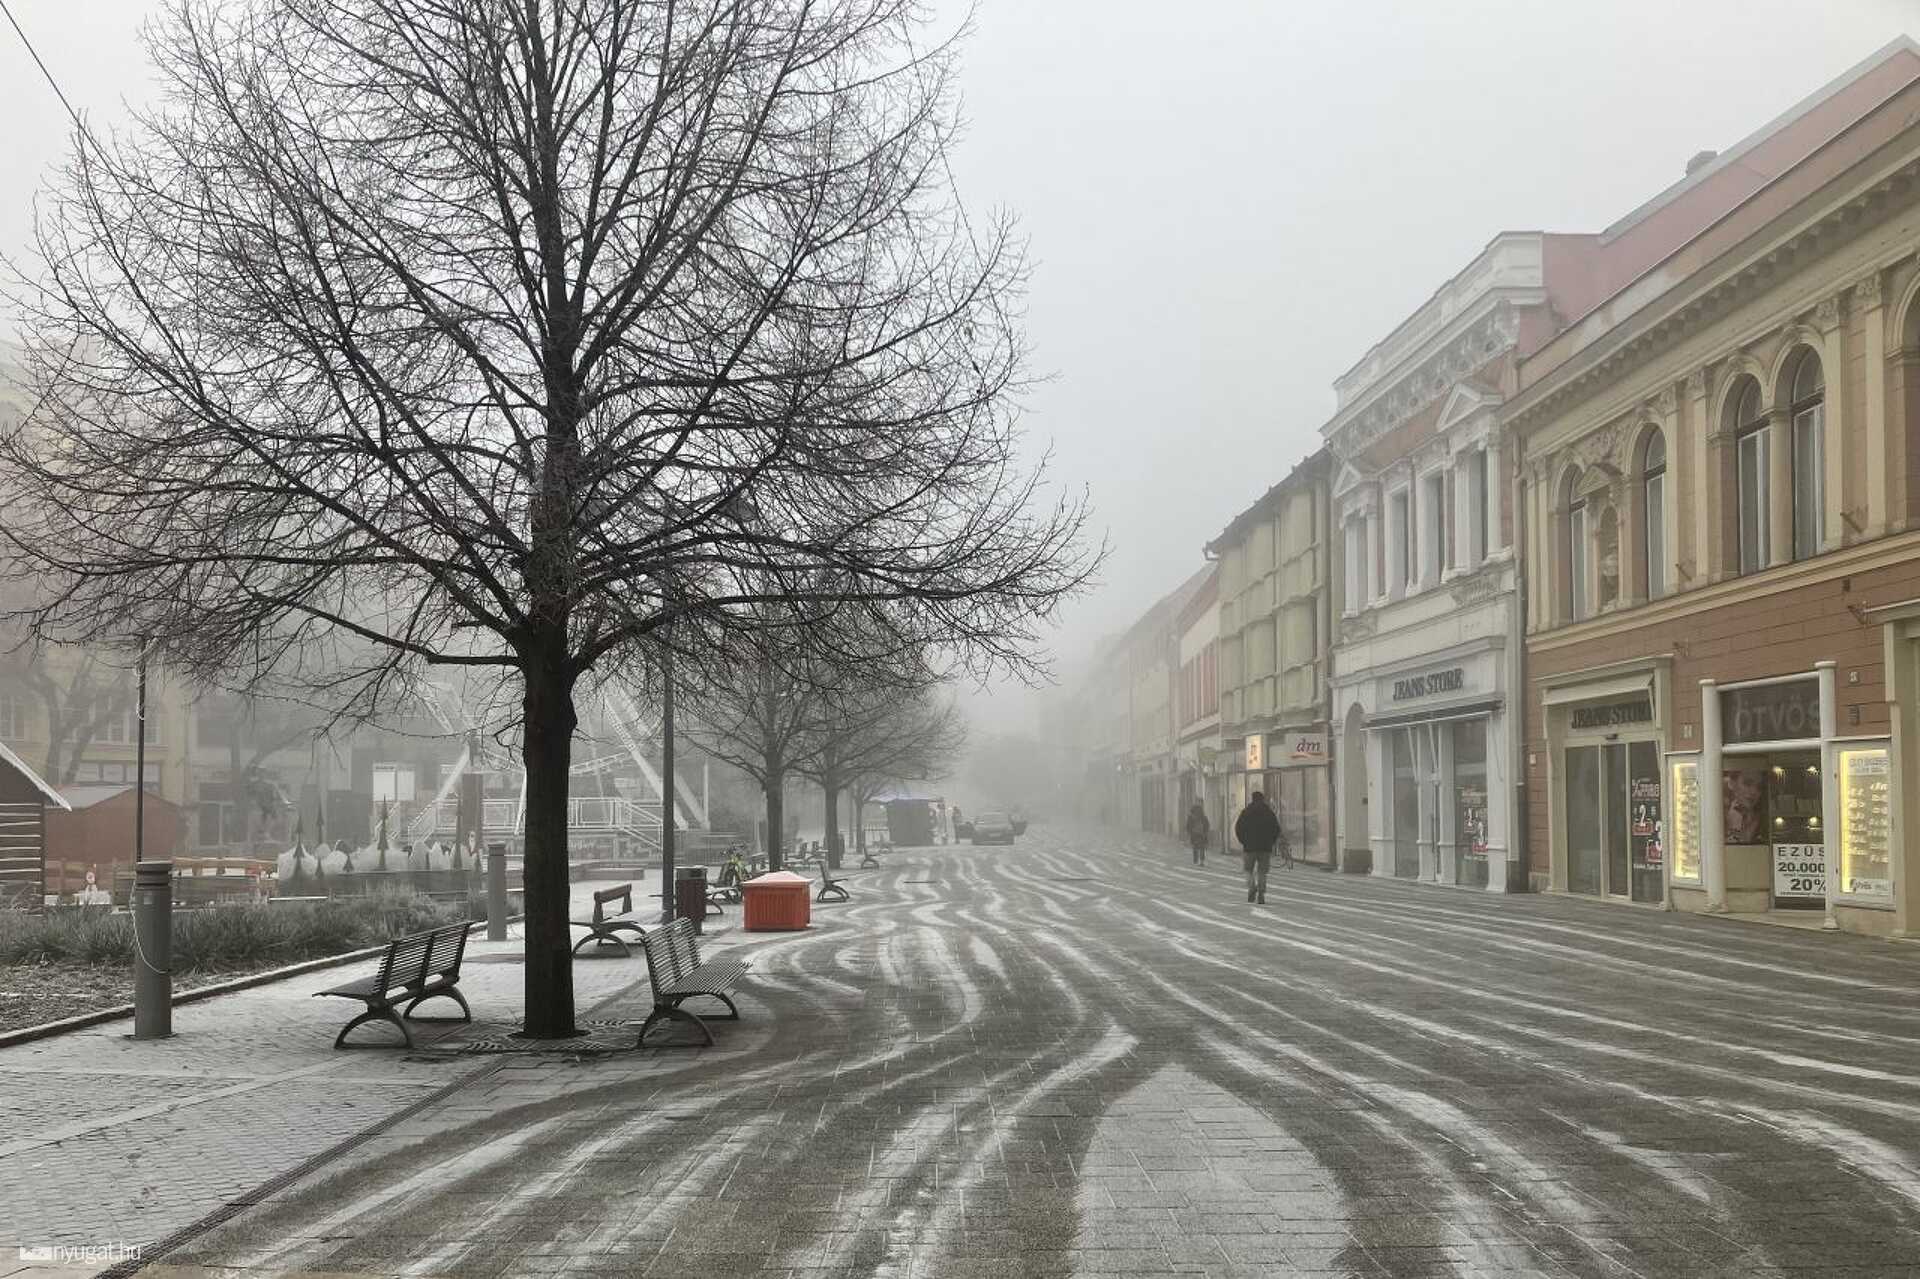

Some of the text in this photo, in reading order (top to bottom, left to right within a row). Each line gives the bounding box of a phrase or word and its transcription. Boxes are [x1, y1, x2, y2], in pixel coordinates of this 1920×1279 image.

[1393, 668, 1464, 700] JEANS STORE
[1296, 738, 1321, 752] dm
